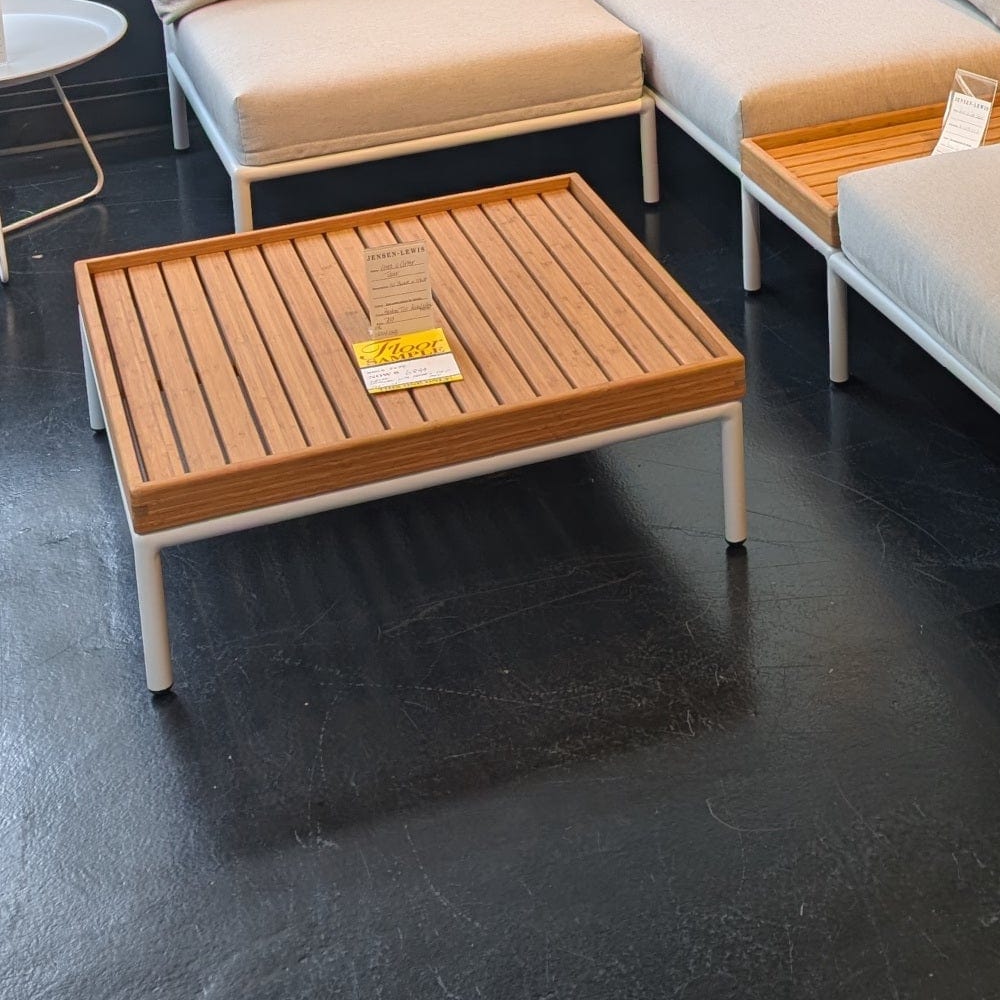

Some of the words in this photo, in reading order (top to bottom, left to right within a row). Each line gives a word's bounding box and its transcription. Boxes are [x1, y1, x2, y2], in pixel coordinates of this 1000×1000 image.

[366, 246, 426, 262] JENSEN-LEWIS
[362, 338, 443, 359] Floor
[366, 346, 446, 366] SAMPLE
